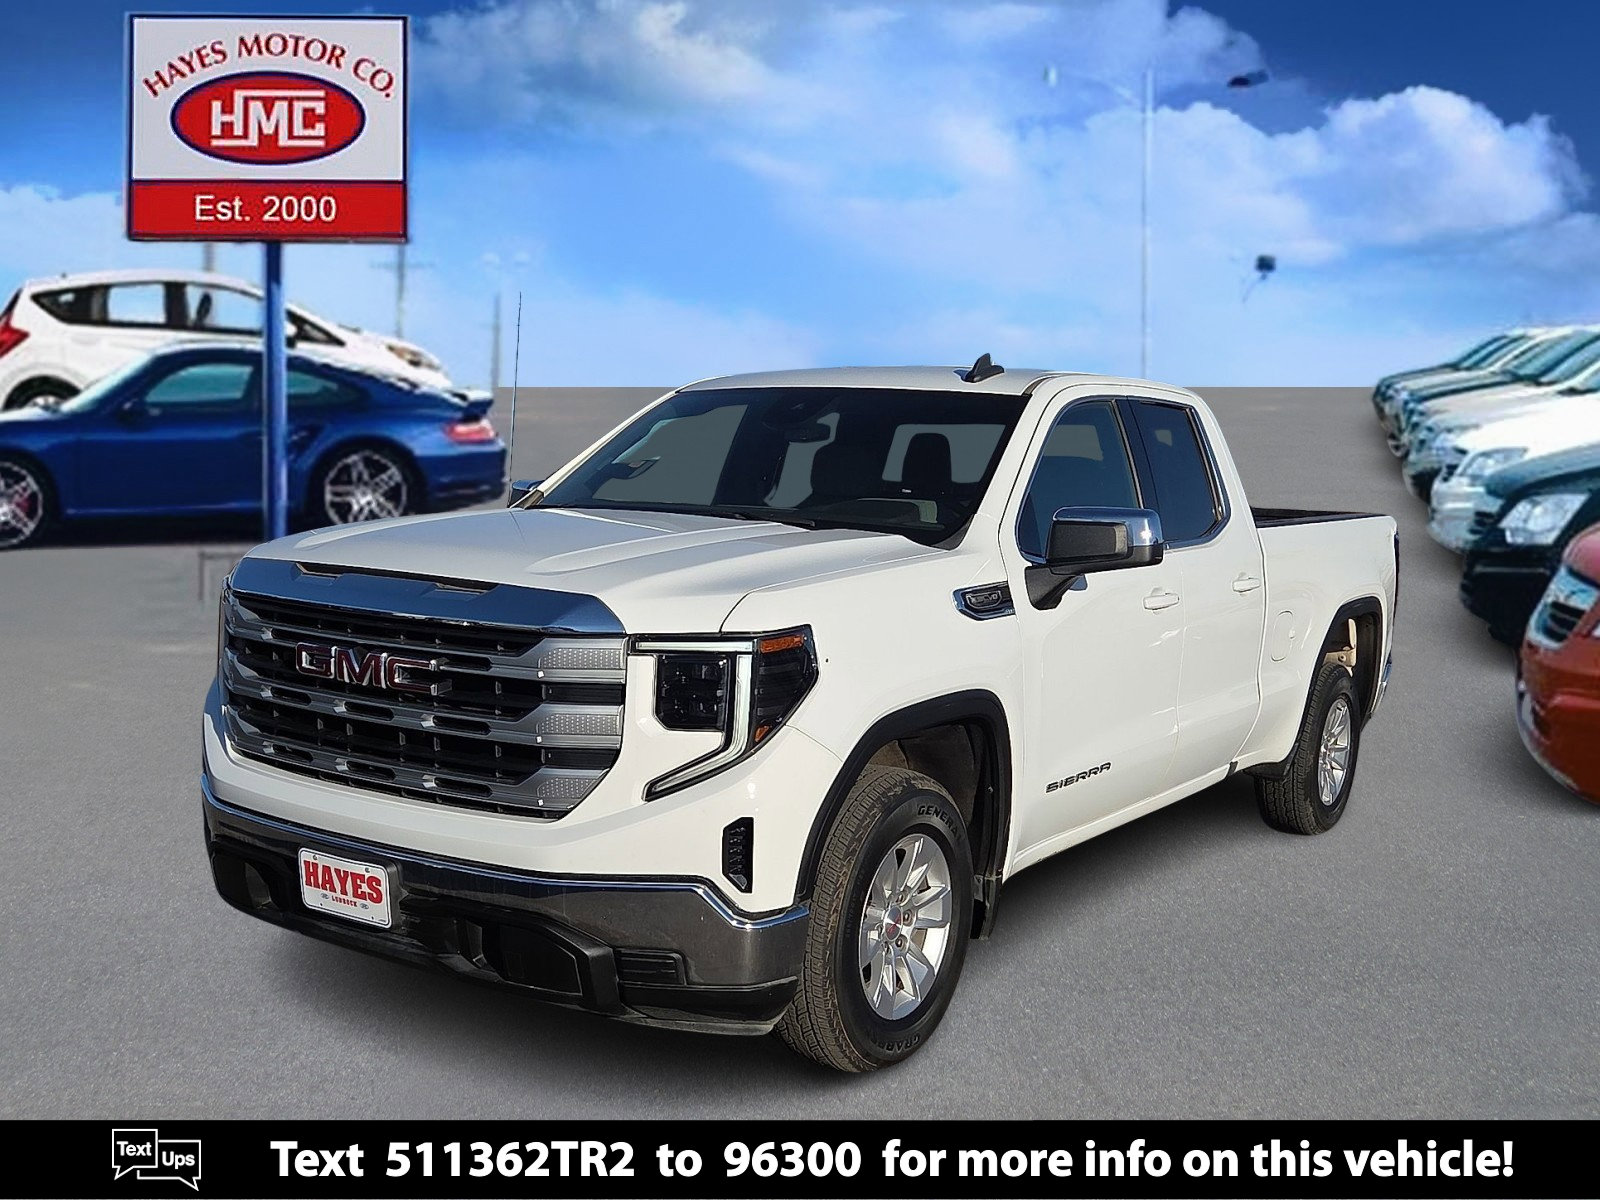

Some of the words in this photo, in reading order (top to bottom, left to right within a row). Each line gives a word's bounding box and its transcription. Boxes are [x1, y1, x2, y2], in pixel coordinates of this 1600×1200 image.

[143, 40, 227, 97] HAYES
[238, 33, 346, 69] MOTOR
[353, 58, 394, 98] CO.
[210, 89, 325, 147] HMC
[194, 194, 250, 222] Est.
[262, 196, 336, 222] 2000
[296, 642, 438, 696] GMC
[1046, 762, 1112, 793] SIERRA
[303, 860, 383, 904] HAYES
